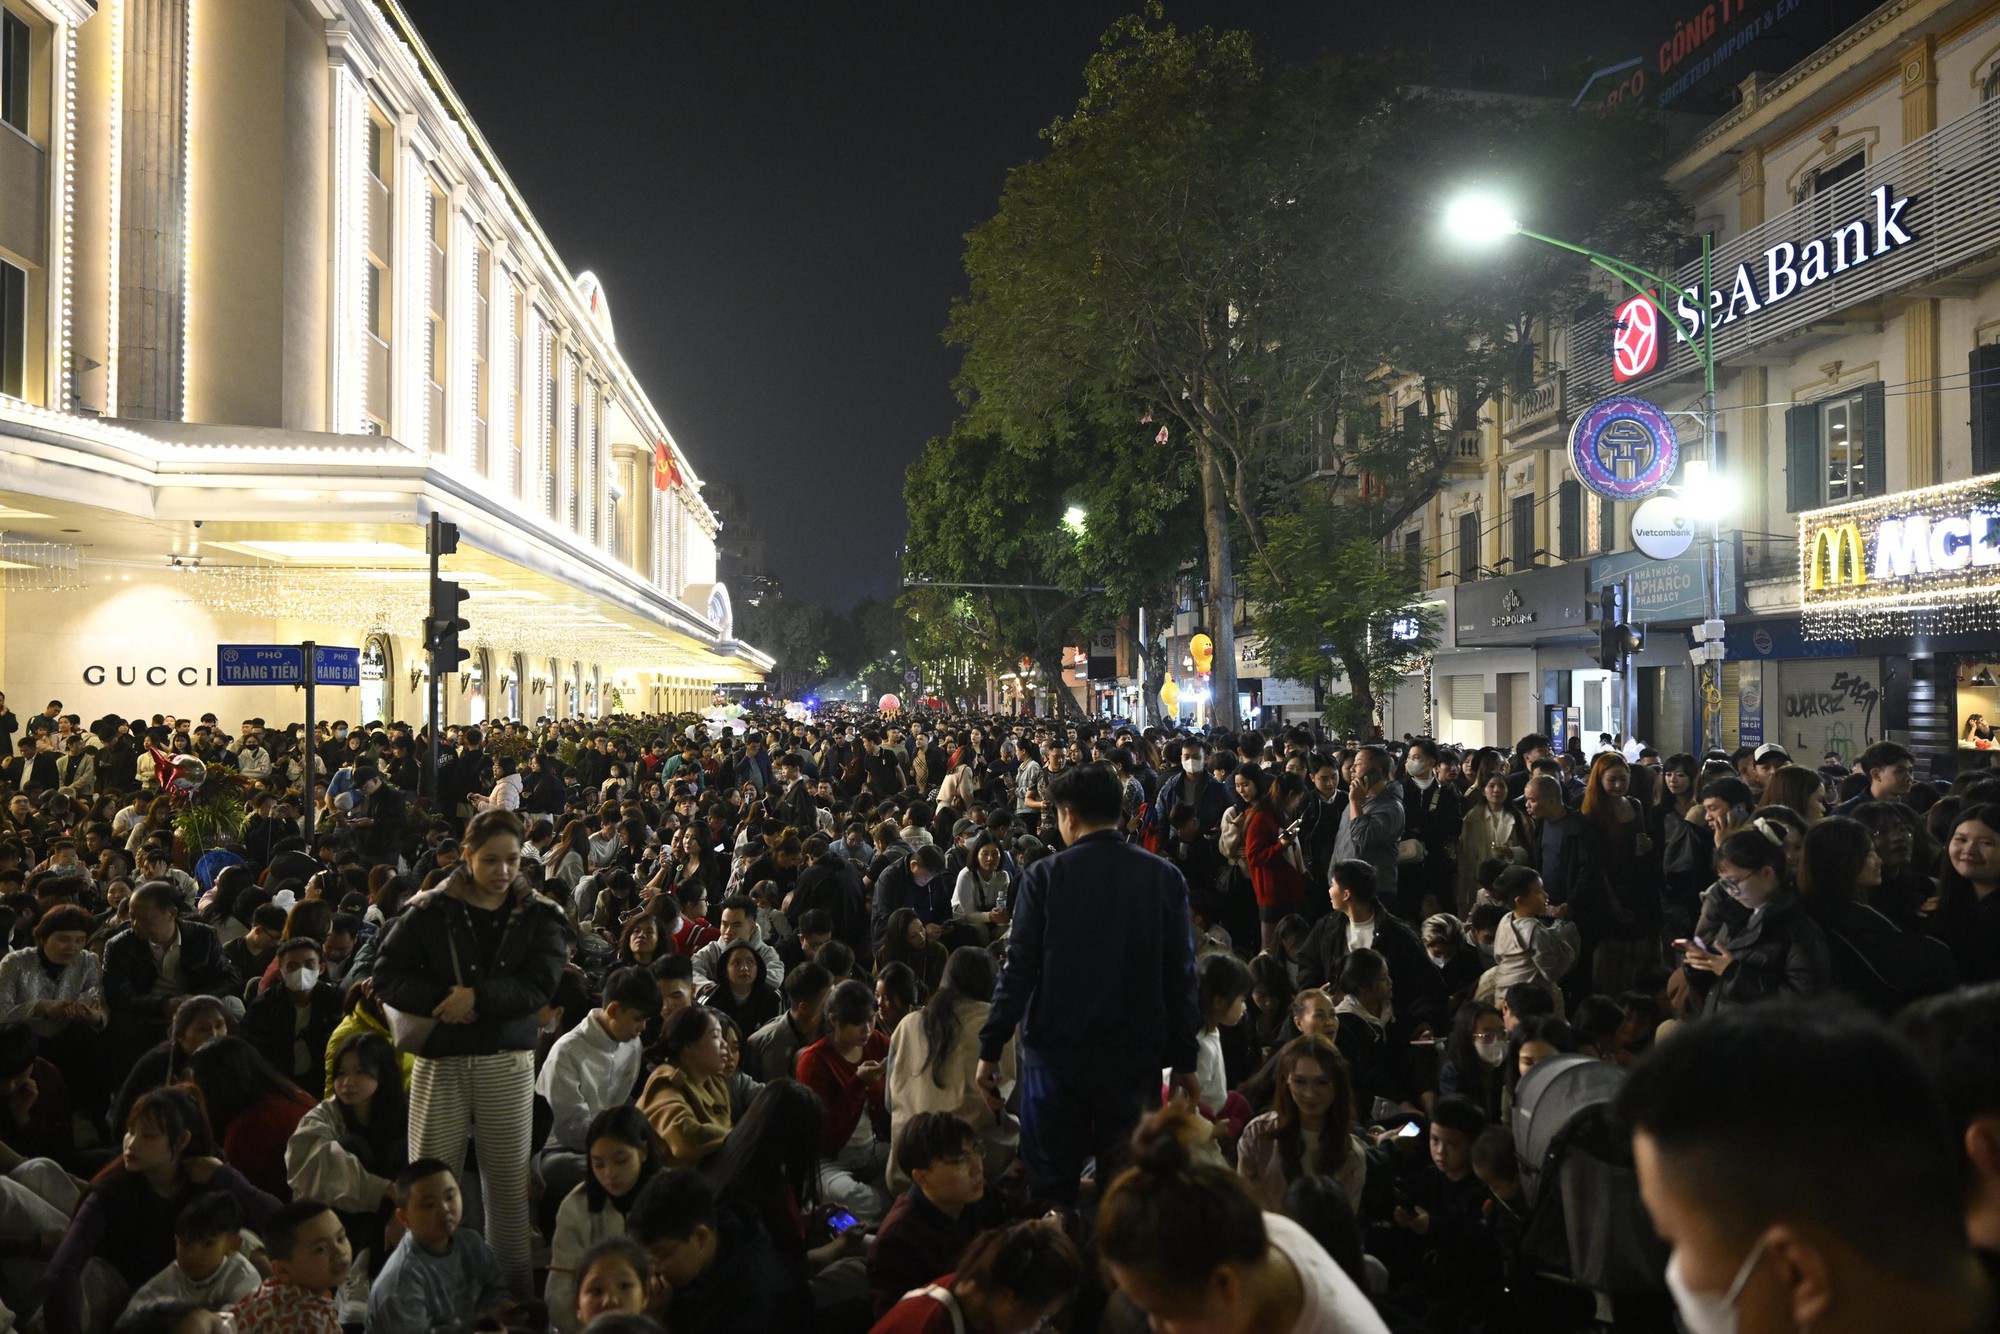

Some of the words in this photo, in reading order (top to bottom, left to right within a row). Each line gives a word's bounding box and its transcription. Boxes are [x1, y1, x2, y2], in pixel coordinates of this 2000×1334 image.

[1659, 5, 1716, 75] CÔNG
[1712, 17, 1761, 68] IMPORT
[1763, 10, 1774, 30] &
[1676, 185, 1913, 344] SeABank
[1635, 527, 1691, 537] Vietcombank
[1634, 567, 1650, 581] NHÀ
[1651, 562, 1680, 578] THUỐC
[1636, 592, 1680, 606] PHARMACY
[256, 649, 283, 660] PHỐ
[333, 652, 349, 661] PHỐ
[83, 665, 212, 686] GUCCI
[226, 662, 268, 680] TRÀNG
[271, 661, 299, 679] TIỀN
[317, 663, 340, 680] HÀNG
[342, 664, 357, 680] BÀI
[1750, 721, 1761, 729] CẬY
